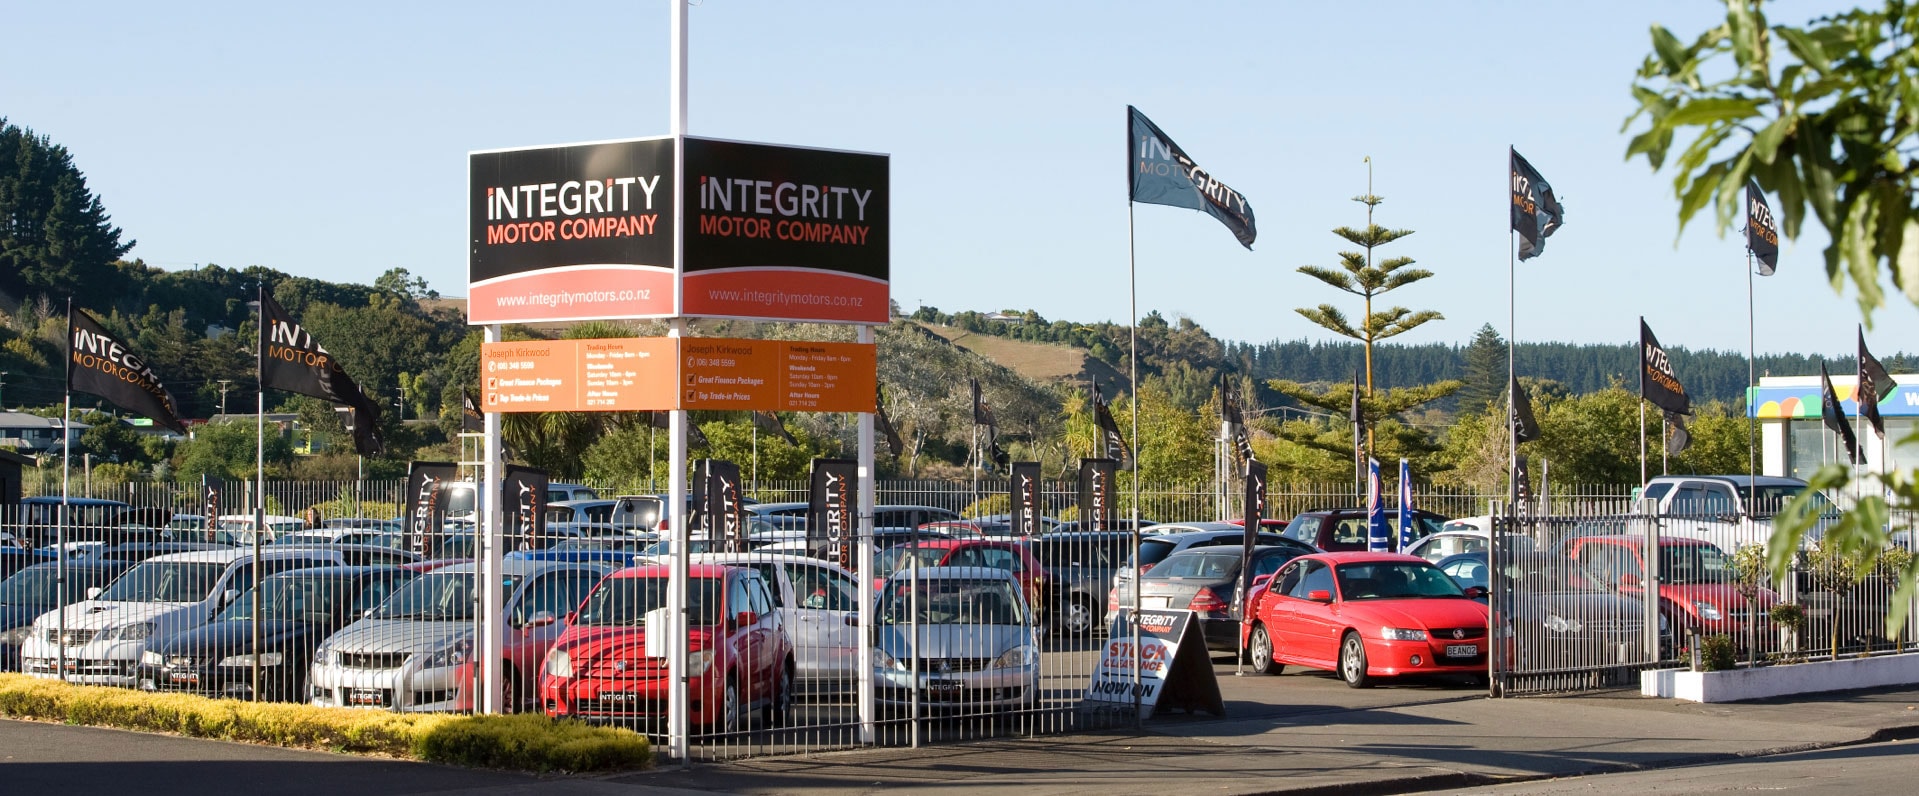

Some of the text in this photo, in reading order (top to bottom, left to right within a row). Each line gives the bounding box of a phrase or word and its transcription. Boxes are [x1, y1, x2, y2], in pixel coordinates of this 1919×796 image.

[487, 214, 658, 245] MOTOR COMPANY
[700, 214, 870, 245] MOTOR COMPANY
[496, 289, 650, 308] www.integritymotors.co.nz
[709, 288, 863, 307] www.integritymotors.co.nz
[269, 345, 328, 368] MOTOR
[488, 348, 550, 359] Joseph Kirkwood
[687, 344, 753, 355] Joseph Kirkwood
[73, 351, 118, 377] MOTOR
[708, 359, 720, 367] 348
[721, 359, 736, 367] 5599
[698, 375, 764, 387] Great Finance Packages
[698, 392, 751, 401] Top Trade-in Prices
[1104, 658, 1164, 672] CLEARNCE
[1093, 680, 1131, 695] NOW
